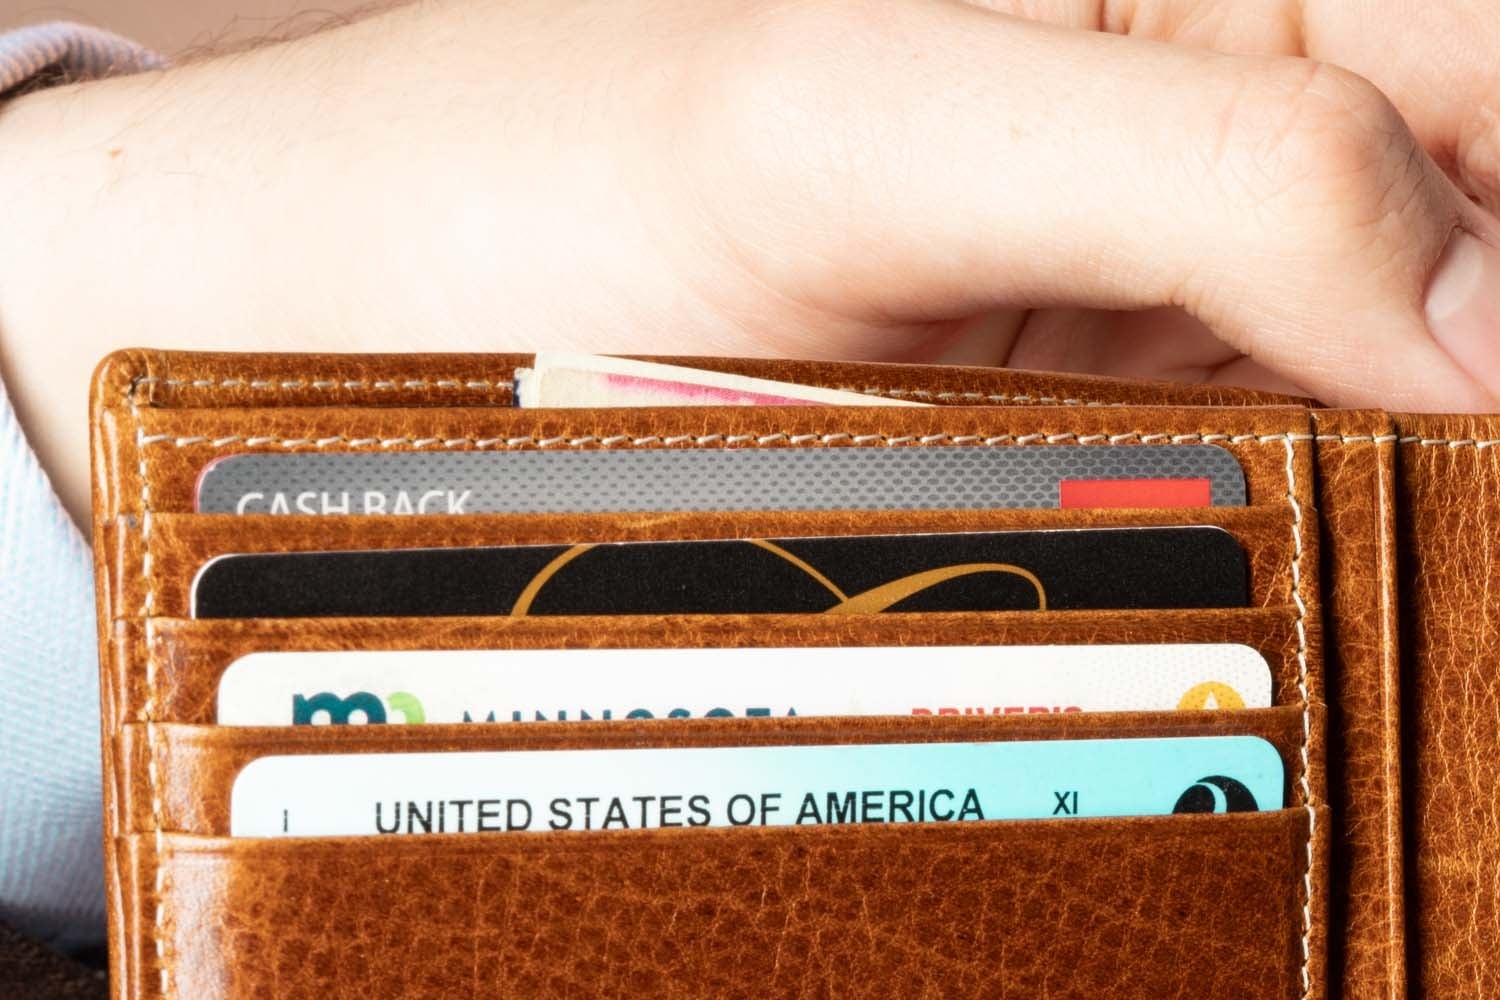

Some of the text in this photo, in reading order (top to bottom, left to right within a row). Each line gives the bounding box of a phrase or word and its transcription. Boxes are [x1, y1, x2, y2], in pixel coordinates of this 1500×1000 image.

[374, 788, 985, 835] UNITED STATES OF AMERICA
